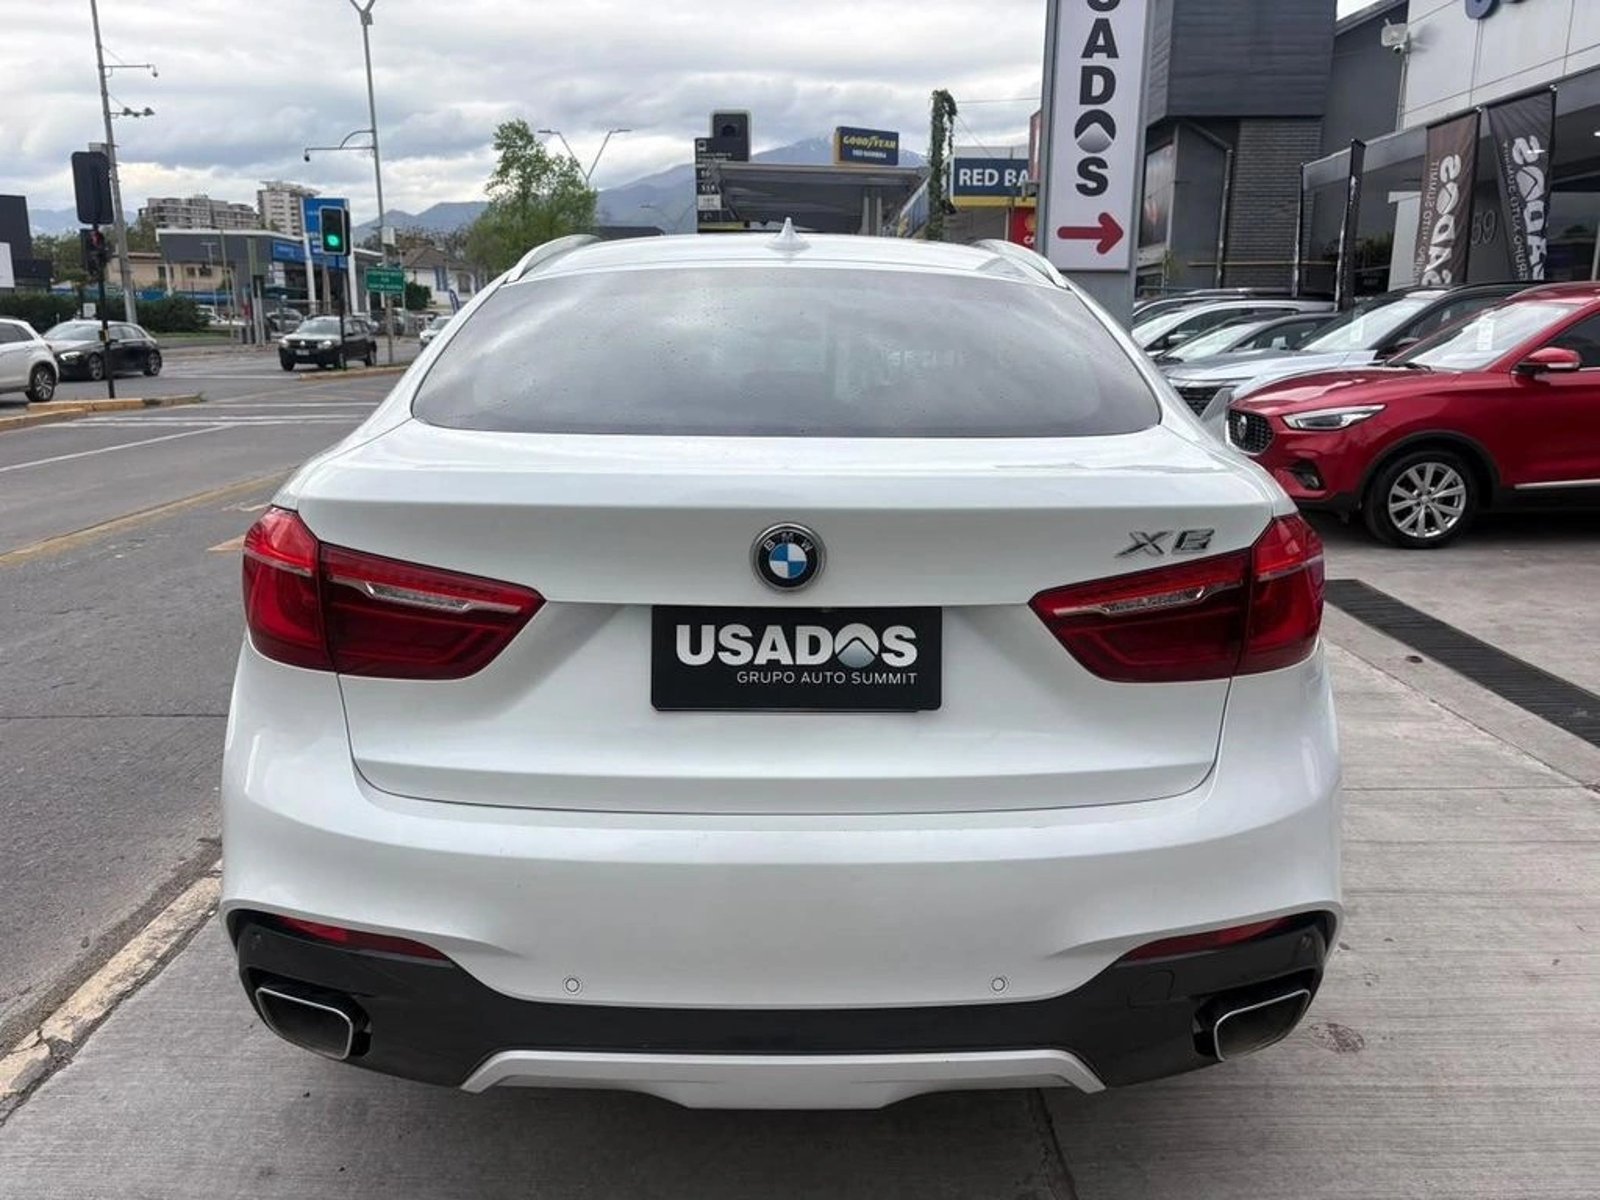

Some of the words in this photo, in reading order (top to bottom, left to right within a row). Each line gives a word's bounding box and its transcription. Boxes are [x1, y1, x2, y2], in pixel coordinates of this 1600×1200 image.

[1074, 0, 1122, 197] ADOS
[958, 168, 999, 187] RED
[764, 532, 814, 552] BMW
[1114, 527, 1216, 559] X6
[675, 622, 919, 668] USADOS
[736, 671, 795, 685] GRUPO
[800, 671, 846, 685] AUTO
[851, 671, 918, 685] SUMMIT
